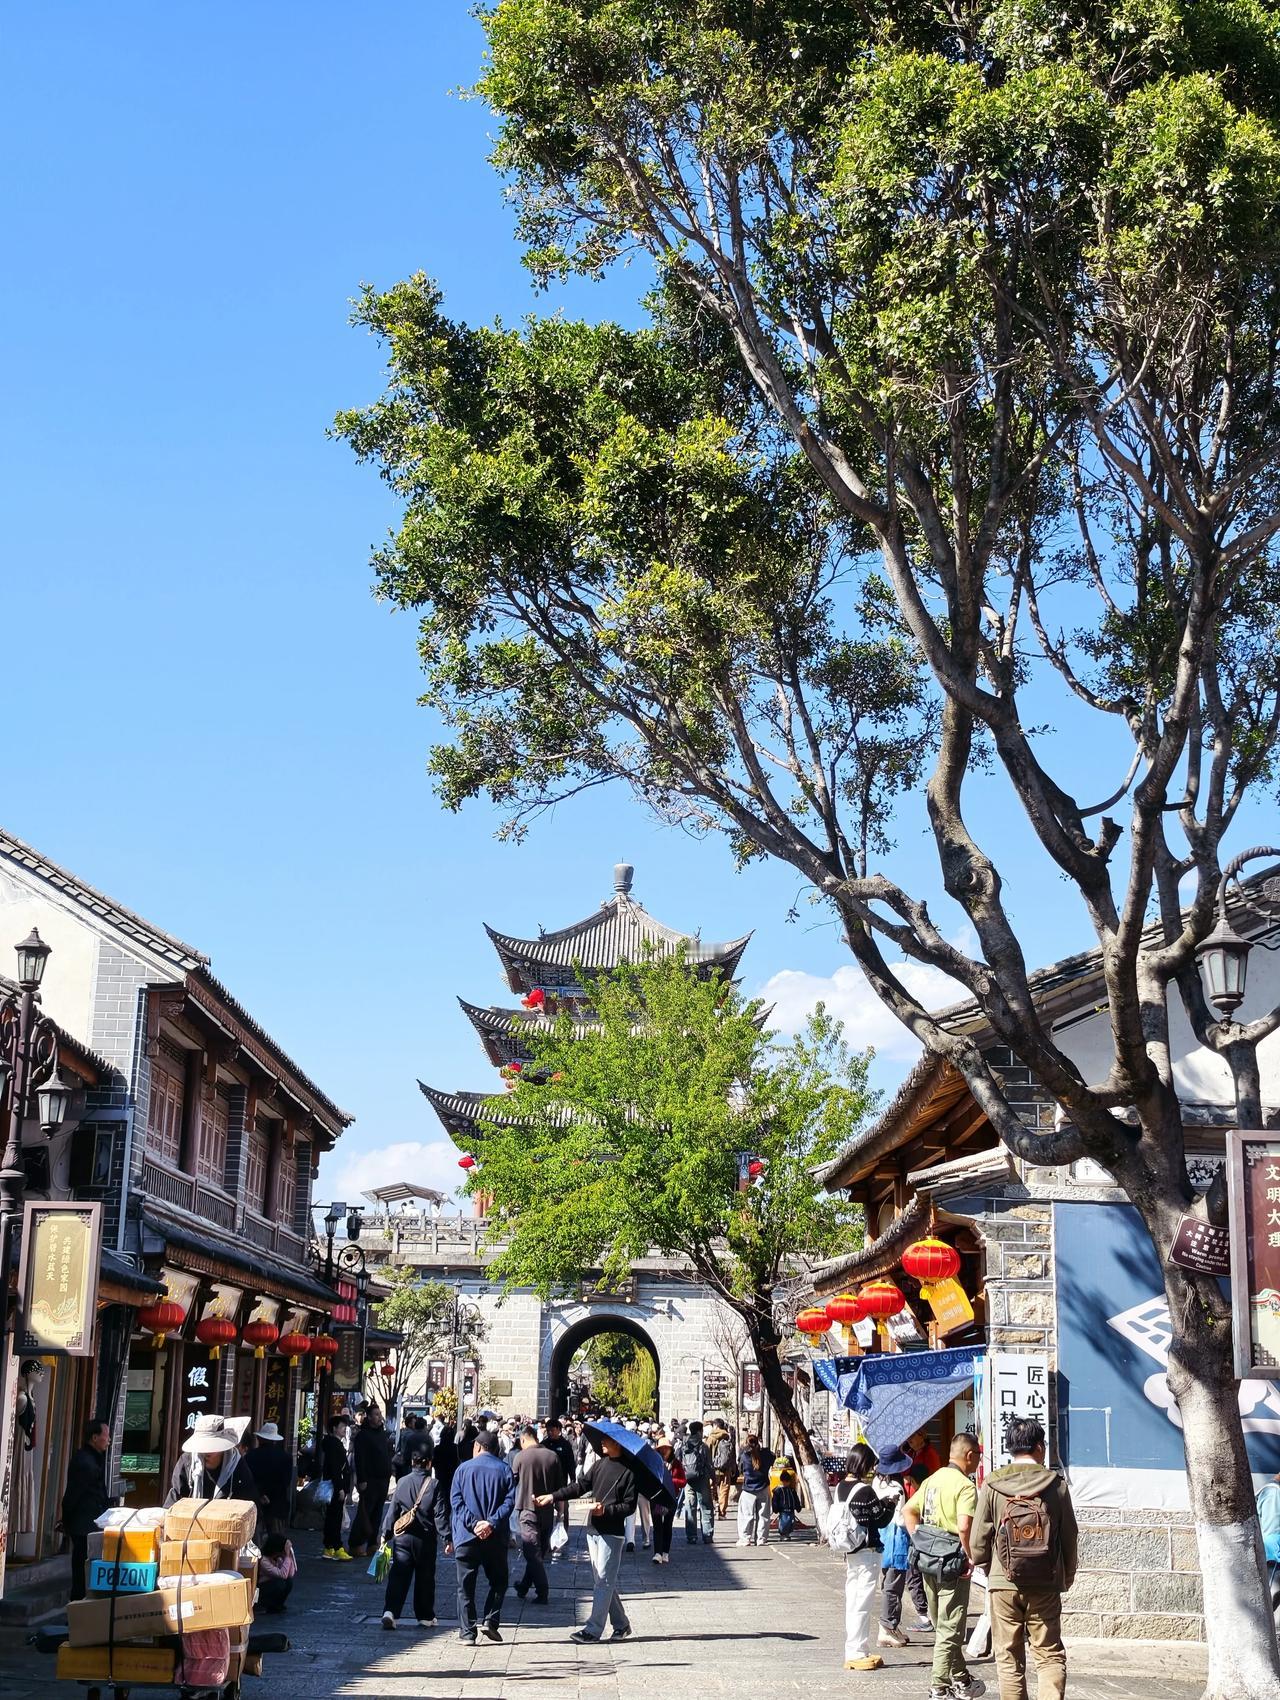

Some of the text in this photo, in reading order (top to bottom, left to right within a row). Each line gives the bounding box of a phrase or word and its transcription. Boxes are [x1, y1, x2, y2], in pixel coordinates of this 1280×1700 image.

[1264, 1164, 1280, 1248] 文明大理
[1191, 1248, 1207, 1257] Warm
